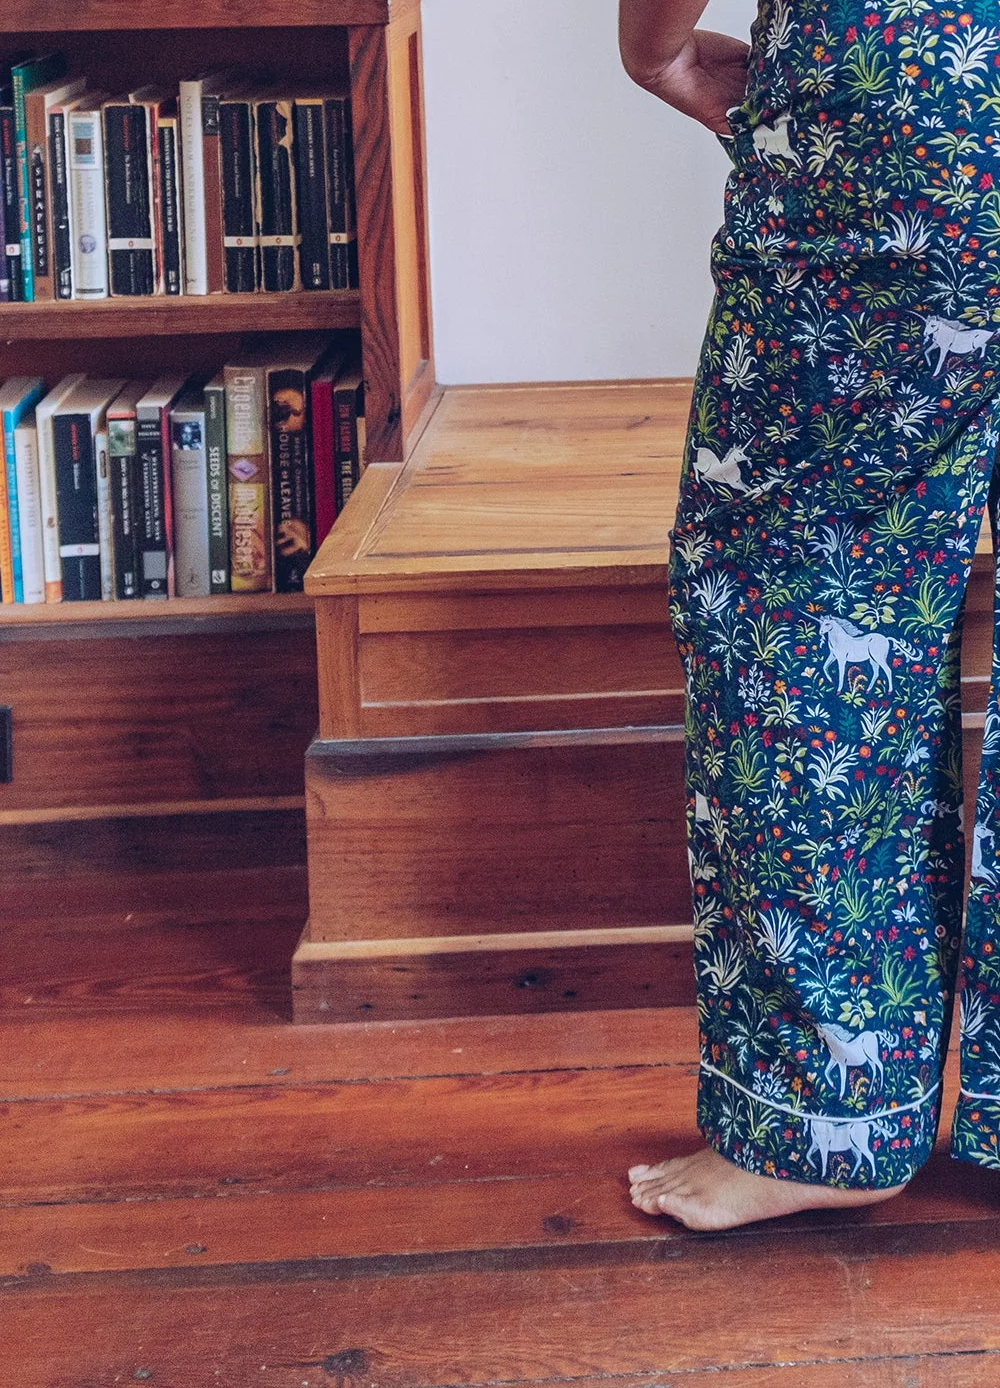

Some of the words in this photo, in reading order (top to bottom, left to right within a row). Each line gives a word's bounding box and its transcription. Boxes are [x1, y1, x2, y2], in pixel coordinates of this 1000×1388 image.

[184, 95, 194, 130] NOTES
[186, 134, 195, 161] FROM
[35, 167, 45, 267] STRAPLESS
[187, 166, 197, 243] UNDERGROUND
